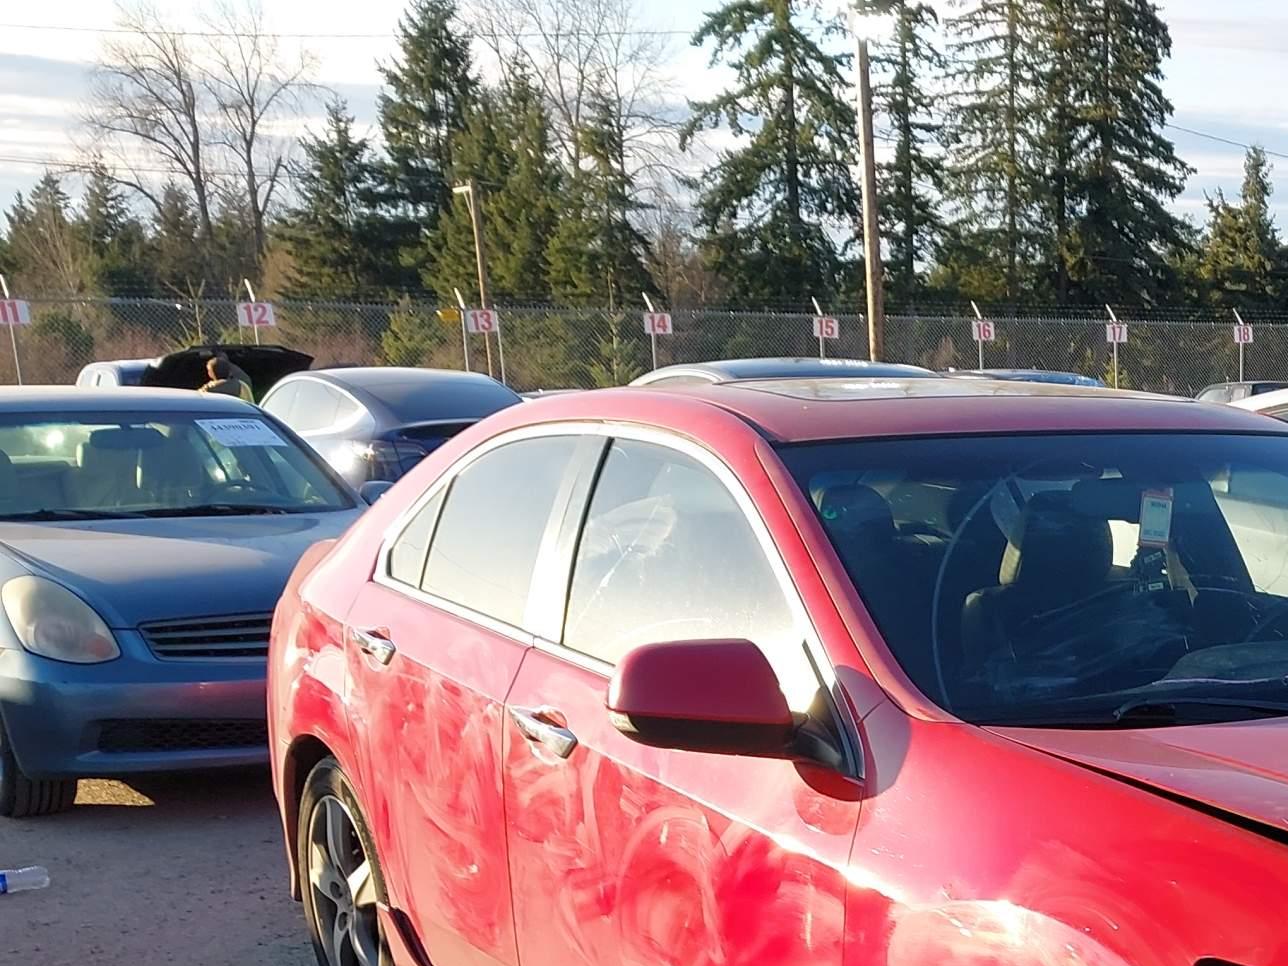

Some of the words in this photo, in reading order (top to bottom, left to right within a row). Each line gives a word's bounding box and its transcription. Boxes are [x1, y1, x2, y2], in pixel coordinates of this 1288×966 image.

[243, 304, 269, 325] 12
[469, 310, 493, 331] 13
[648, 314, 668, 334] 14
[818, 319, 834, 338] 15
[976, 324, 992, 340] 16
[1111, 325, 1123, 341] 17
[1237, 326, 1250, 342] 18
